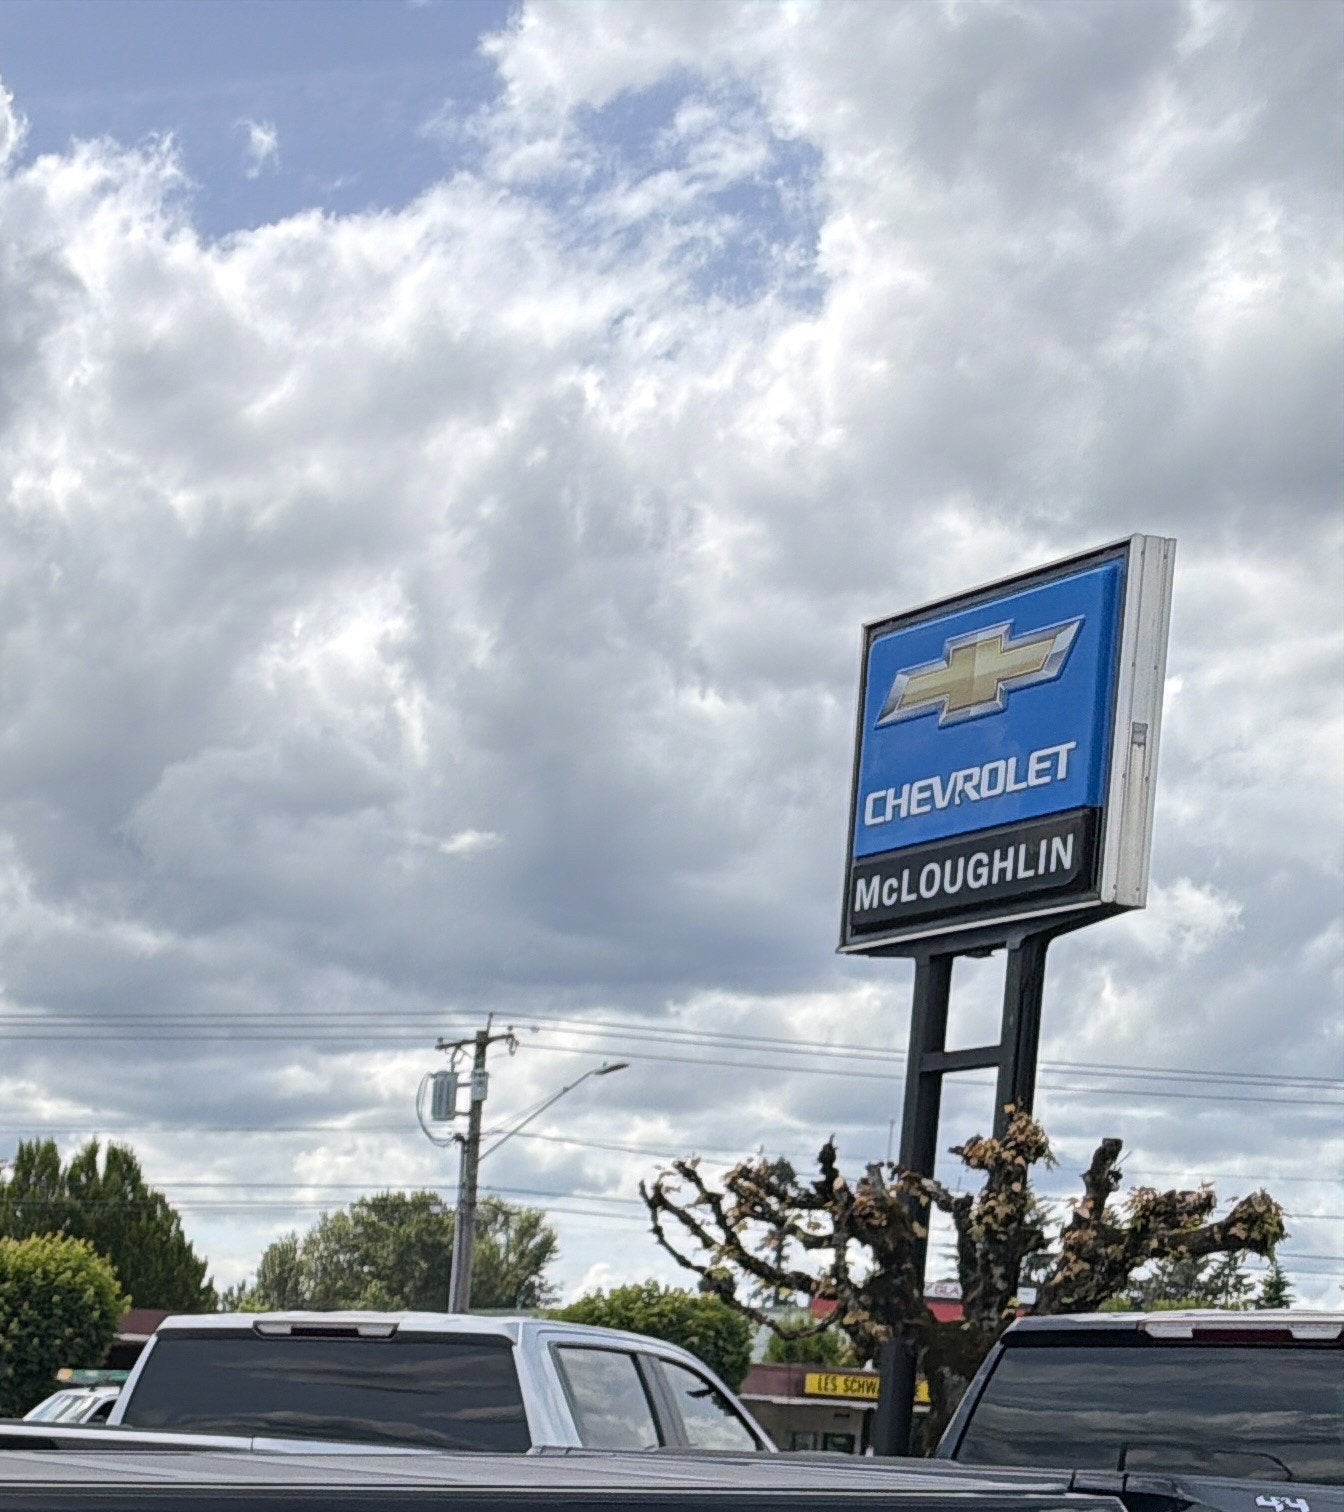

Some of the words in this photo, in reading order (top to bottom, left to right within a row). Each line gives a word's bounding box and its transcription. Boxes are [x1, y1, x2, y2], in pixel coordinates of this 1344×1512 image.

[864, 741, 1077, 826] CHEVROLET
[854, 832, 1075, 912] McLOUGHLIN
[843, 1377, 877, 1395] SCHW
